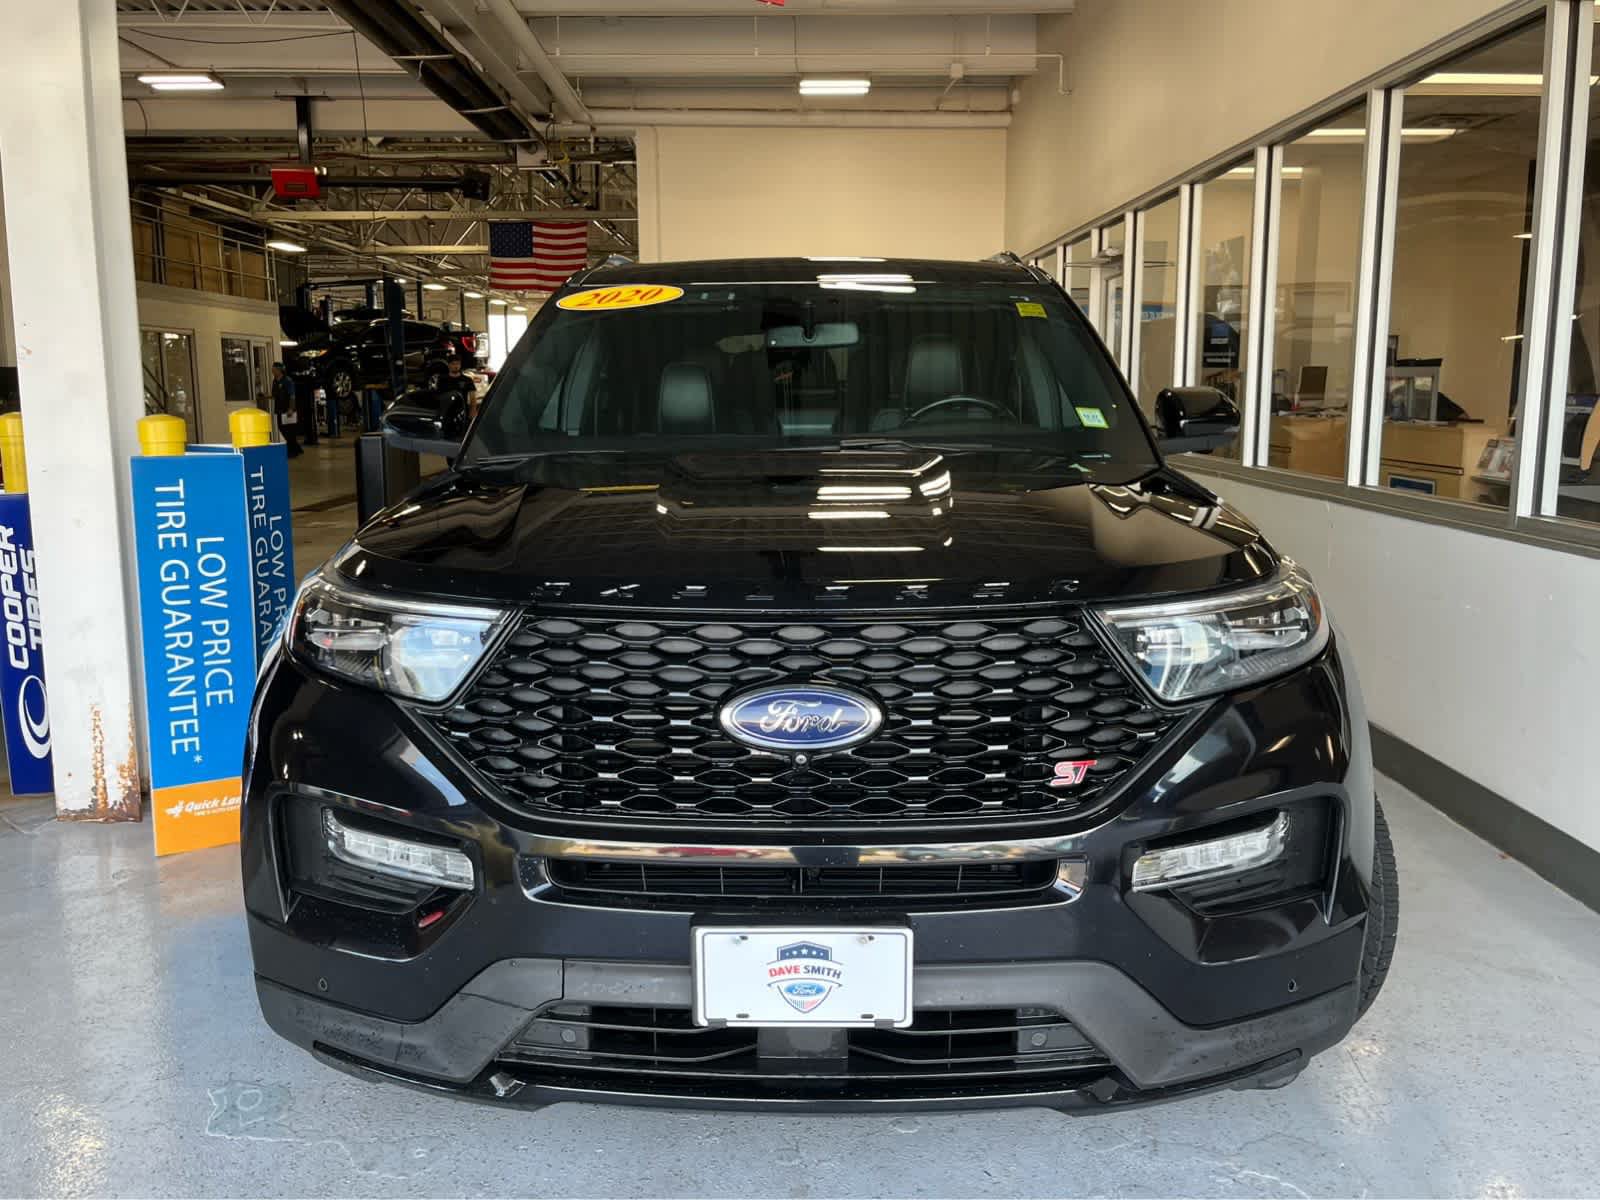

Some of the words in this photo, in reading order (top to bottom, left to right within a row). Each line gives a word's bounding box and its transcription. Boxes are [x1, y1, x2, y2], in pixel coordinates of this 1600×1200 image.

[575, 288, 663, 306] 2020
[154, 478, 188, 550] TIRE
[250, 465, 268, 529] TIRE
[196, 536, 228, 609] LOW
[269, 515, 286, 578] LOW
[0, 525, 30, 670] COOPER
[20, 548, 42, 650] TIRES
[201, 619, 234, 707] PRICE
[760, 700, 842, 732] Ford
[185, 797, 219, 813] Quick
[220, 795, 241, 806] Lan
[1050, 760, 1097, 787] ST
[769, 965, 800, 978] DAVE
[803, 965, 842, 979] SMITH
[791, 984, 817, 996] Ford
